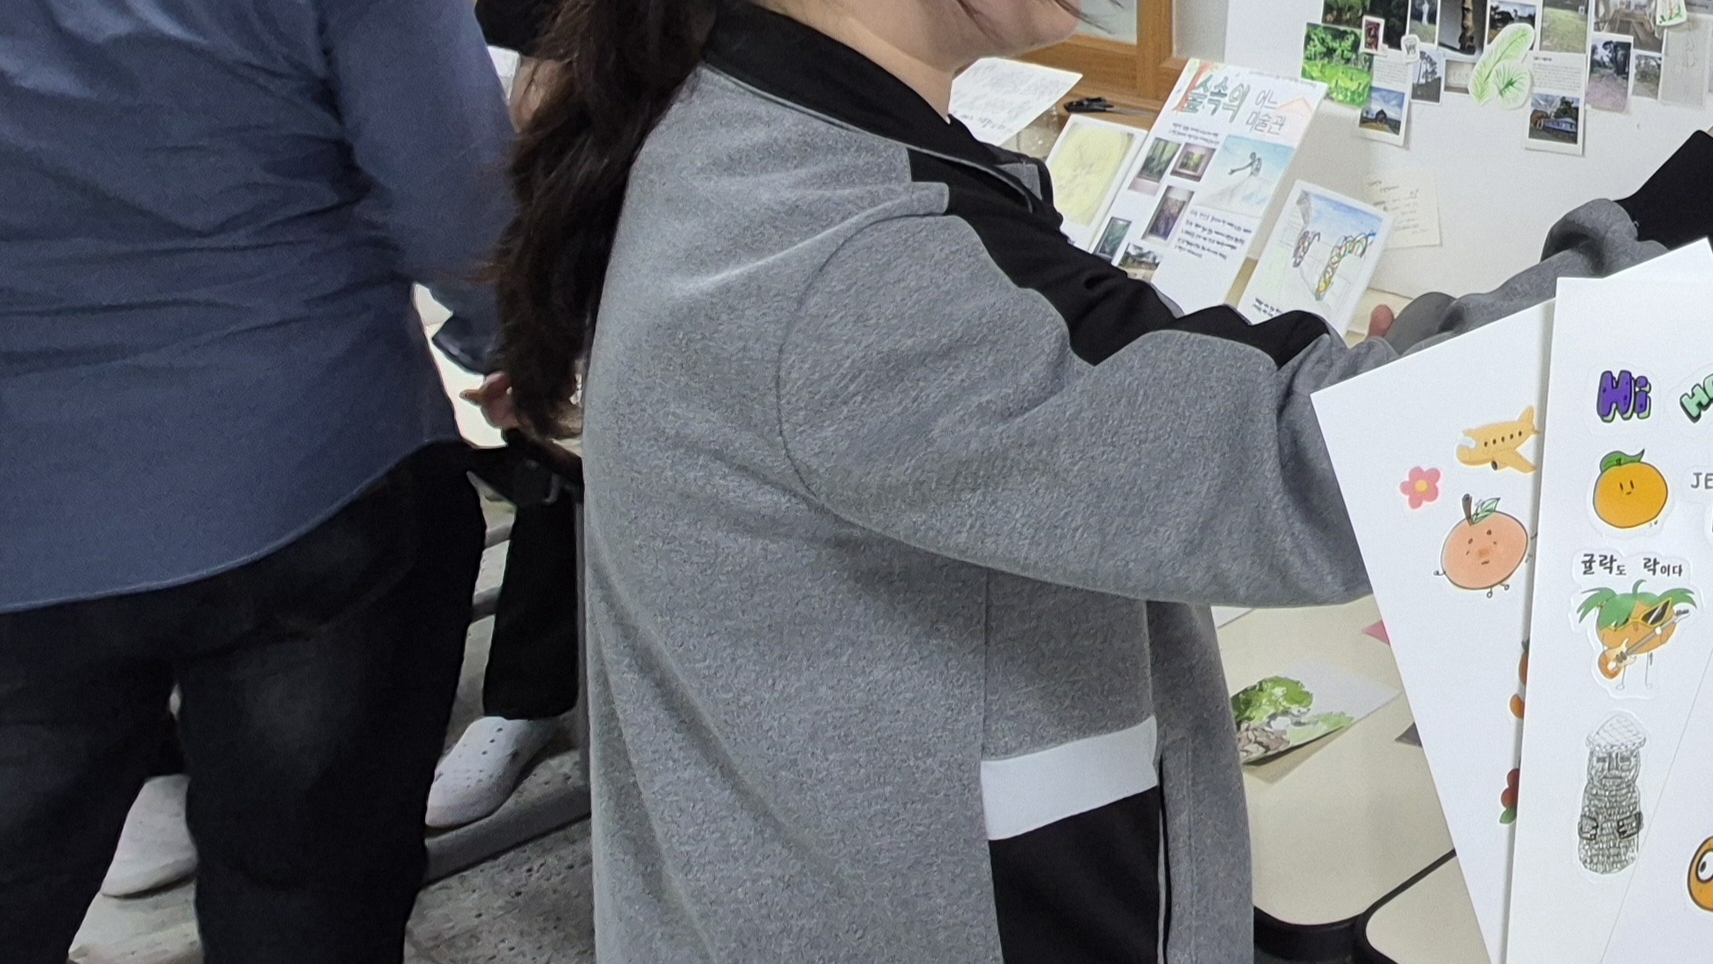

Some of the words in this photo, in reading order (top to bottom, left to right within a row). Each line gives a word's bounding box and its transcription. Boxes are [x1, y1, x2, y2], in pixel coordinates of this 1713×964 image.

[1185, 73, 1250, 123] 숲속의
[1245, 110, 1287, 136] 미술관
[1597, 370, 1651, 423] Hi
[1642, 557, 1683, 577] 락이다
